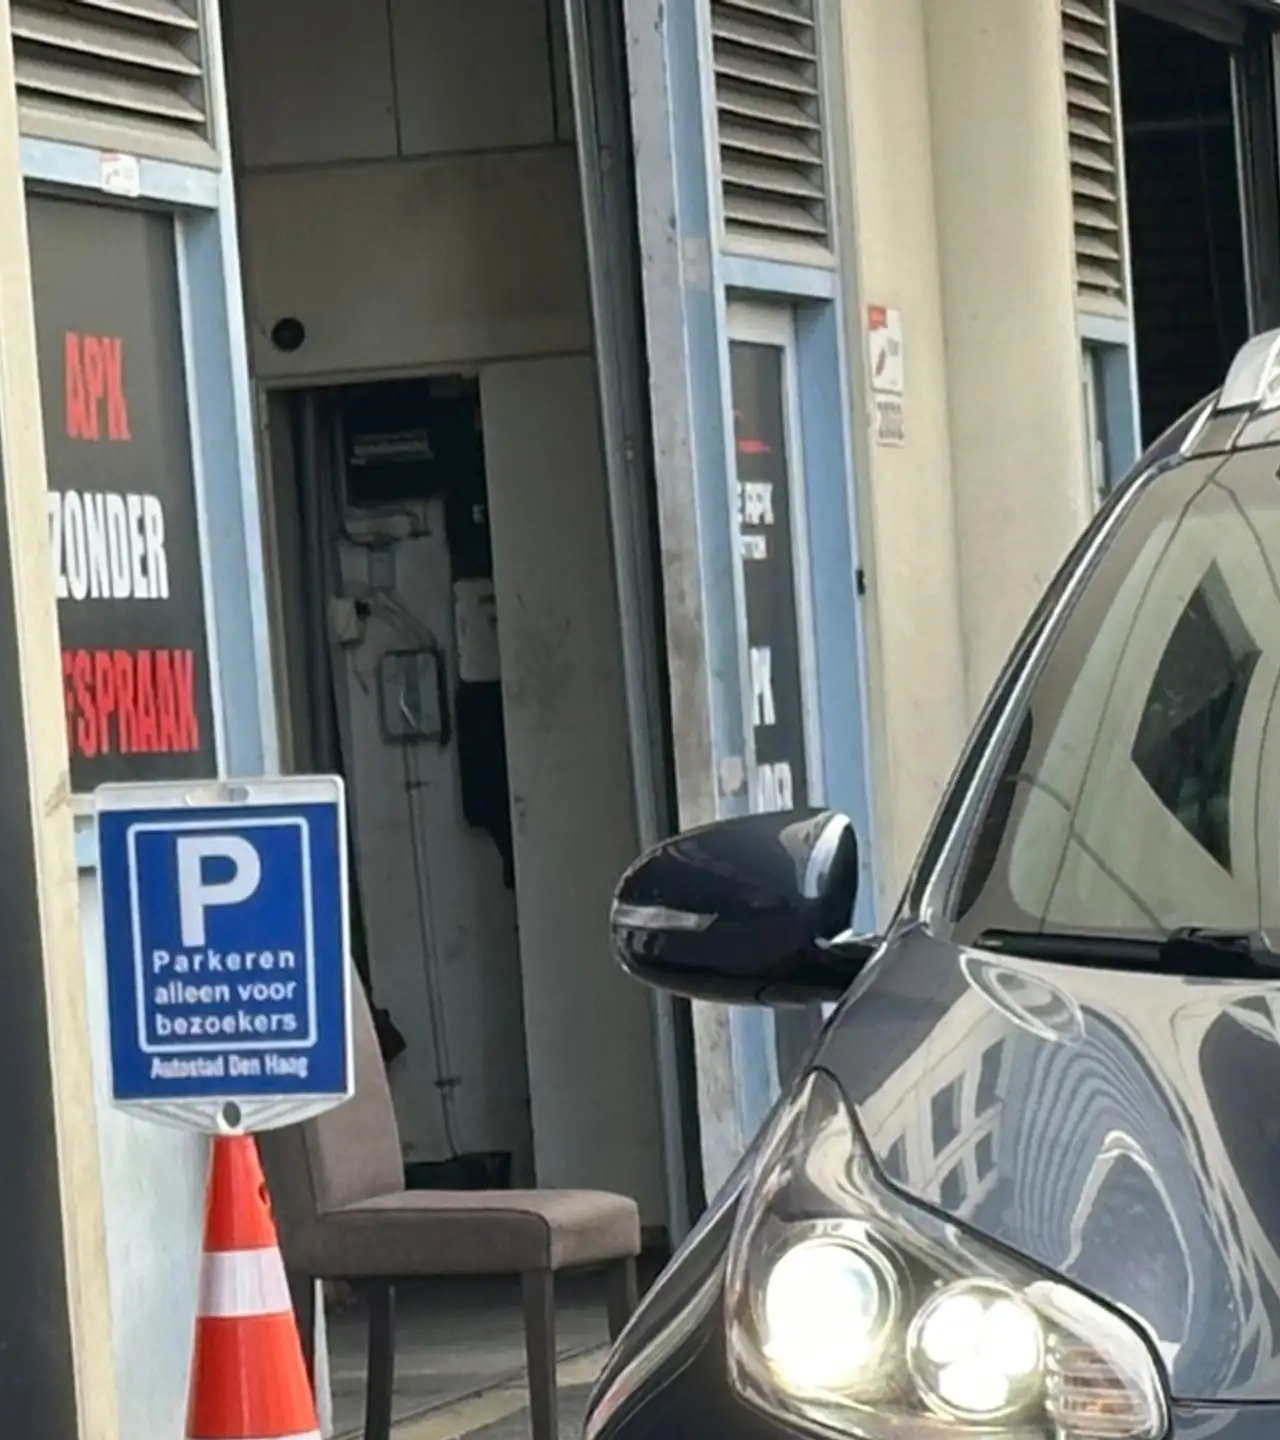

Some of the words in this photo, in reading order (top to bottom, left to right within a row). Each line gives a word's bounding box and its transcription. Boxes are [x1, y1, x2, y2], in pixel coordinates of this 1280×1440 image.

[64, 329, 132, 441] APK
[47, 490, 170, 600] ZONDER
[176, 836, 261, 947] P
[152, 948, 296, 974] Parkeren
[155, 980, 230, 1005] alleen
[237, 980, 297, 1002] voor
[155, 1010, 297, 1036] bezoekers
[150, 1055, 224, 1079] Autostad
[228, 1054, 261, 1077] Den
[264, 1053, 308, 1078] Haag
